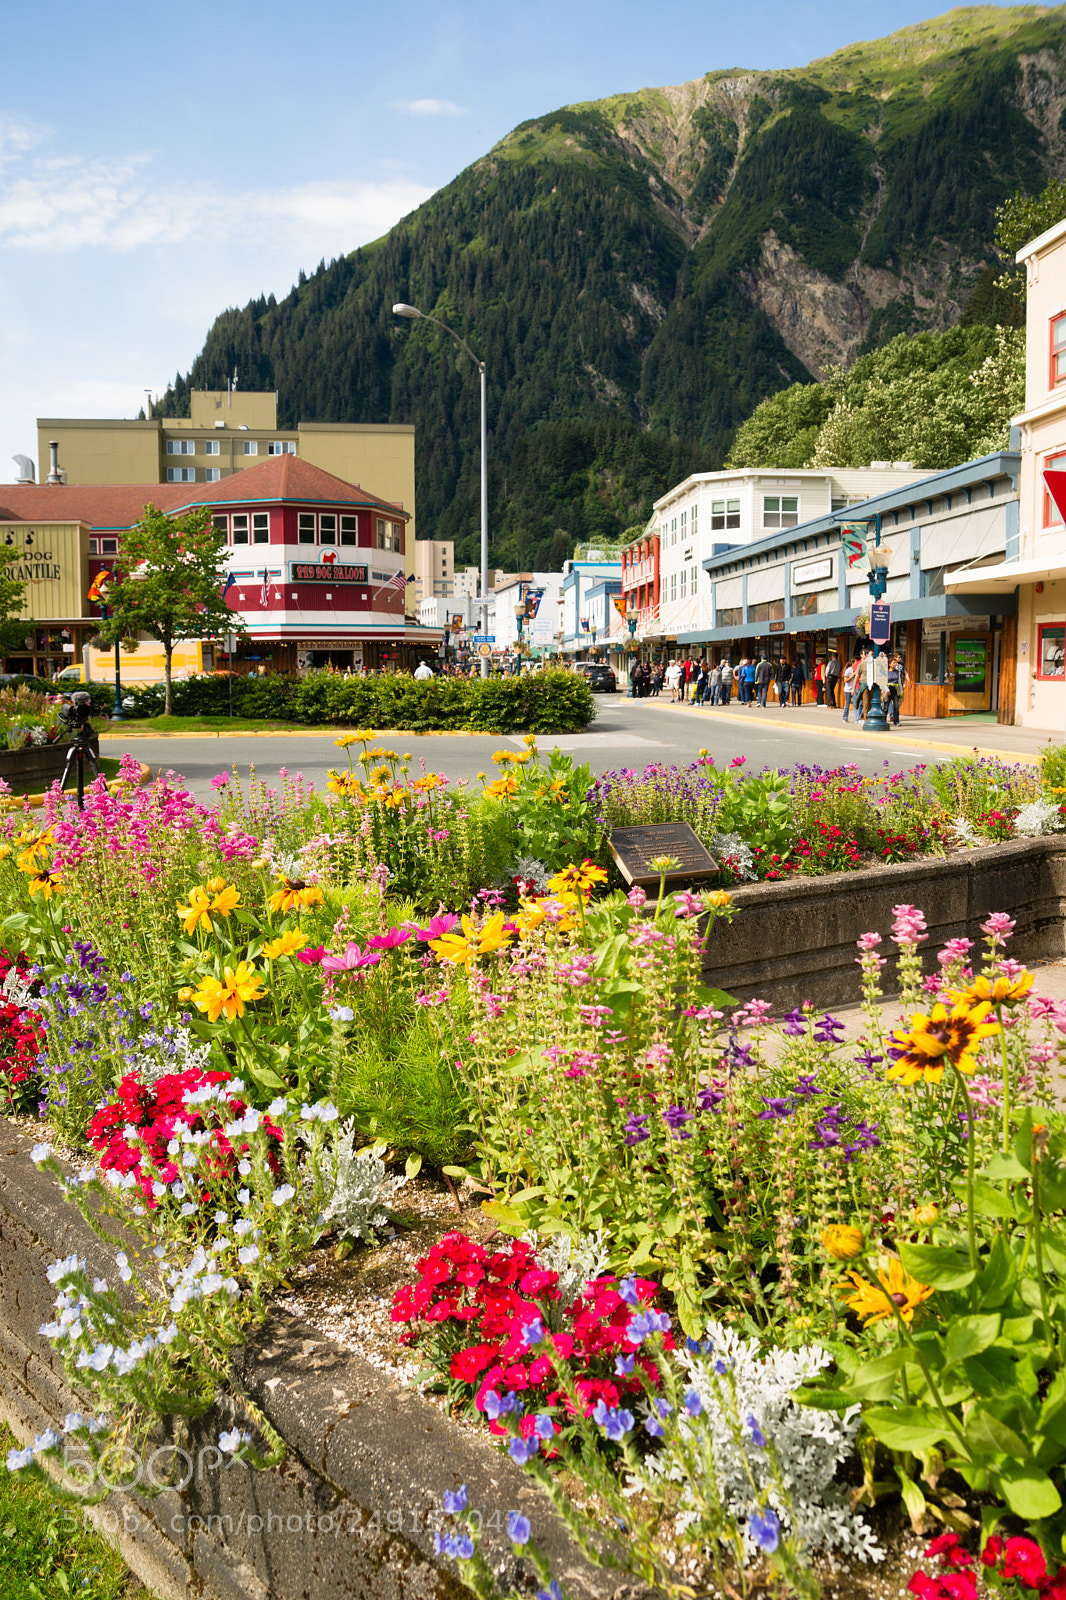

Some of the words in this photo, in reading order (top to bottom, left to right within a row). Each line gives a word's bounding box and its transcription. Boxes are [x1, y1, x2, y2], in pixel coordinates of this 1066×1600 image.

[24, 551, 53, 561] DOG
[4, 563, 61, 582] RCANTILE
[297, 565, 315, 579] RED
[316, 566, 332, 580] DOG
[333, 566, 365, 580] SALOON
